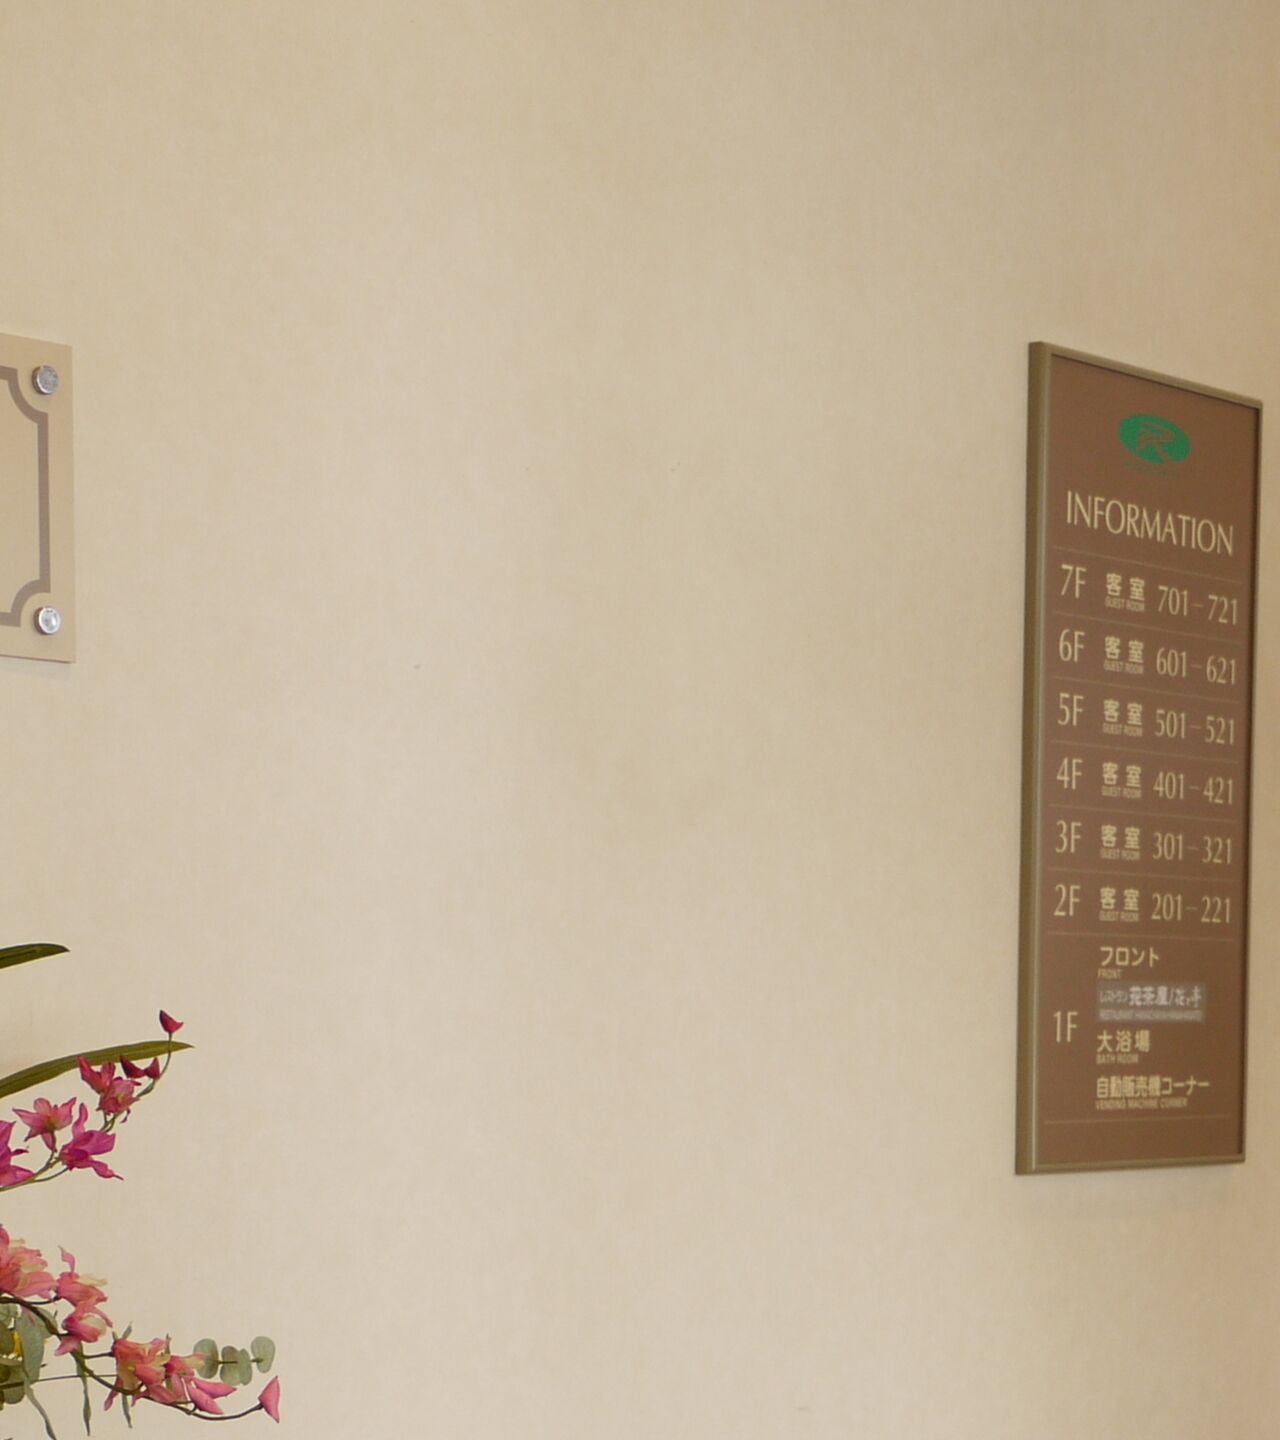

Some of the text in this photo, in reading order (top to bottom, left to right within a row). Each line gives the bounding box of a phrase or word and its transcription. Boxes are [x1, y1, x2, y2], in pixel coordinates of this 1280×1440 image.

[1066, 490, 1233, 556] INFORMATION
[1060, 564, 1087, 598] 7F
[1059, 628, 1085, 662] 6F
[1058, 692, 1084, 726] 5F
[1056, 757, 1083, 789] 4F
[1055, 820, 1082, 853] 3F
[1054, 884, 1080, 916] 2F
[1100, 946, 1159, 968] フロント
[1053, 1011, 1078, 1043] 1F
[1097, 1030, 1150, 1053] 大浴場
[1097, 1075, 1210, 1098] 自動販売機コーナー
